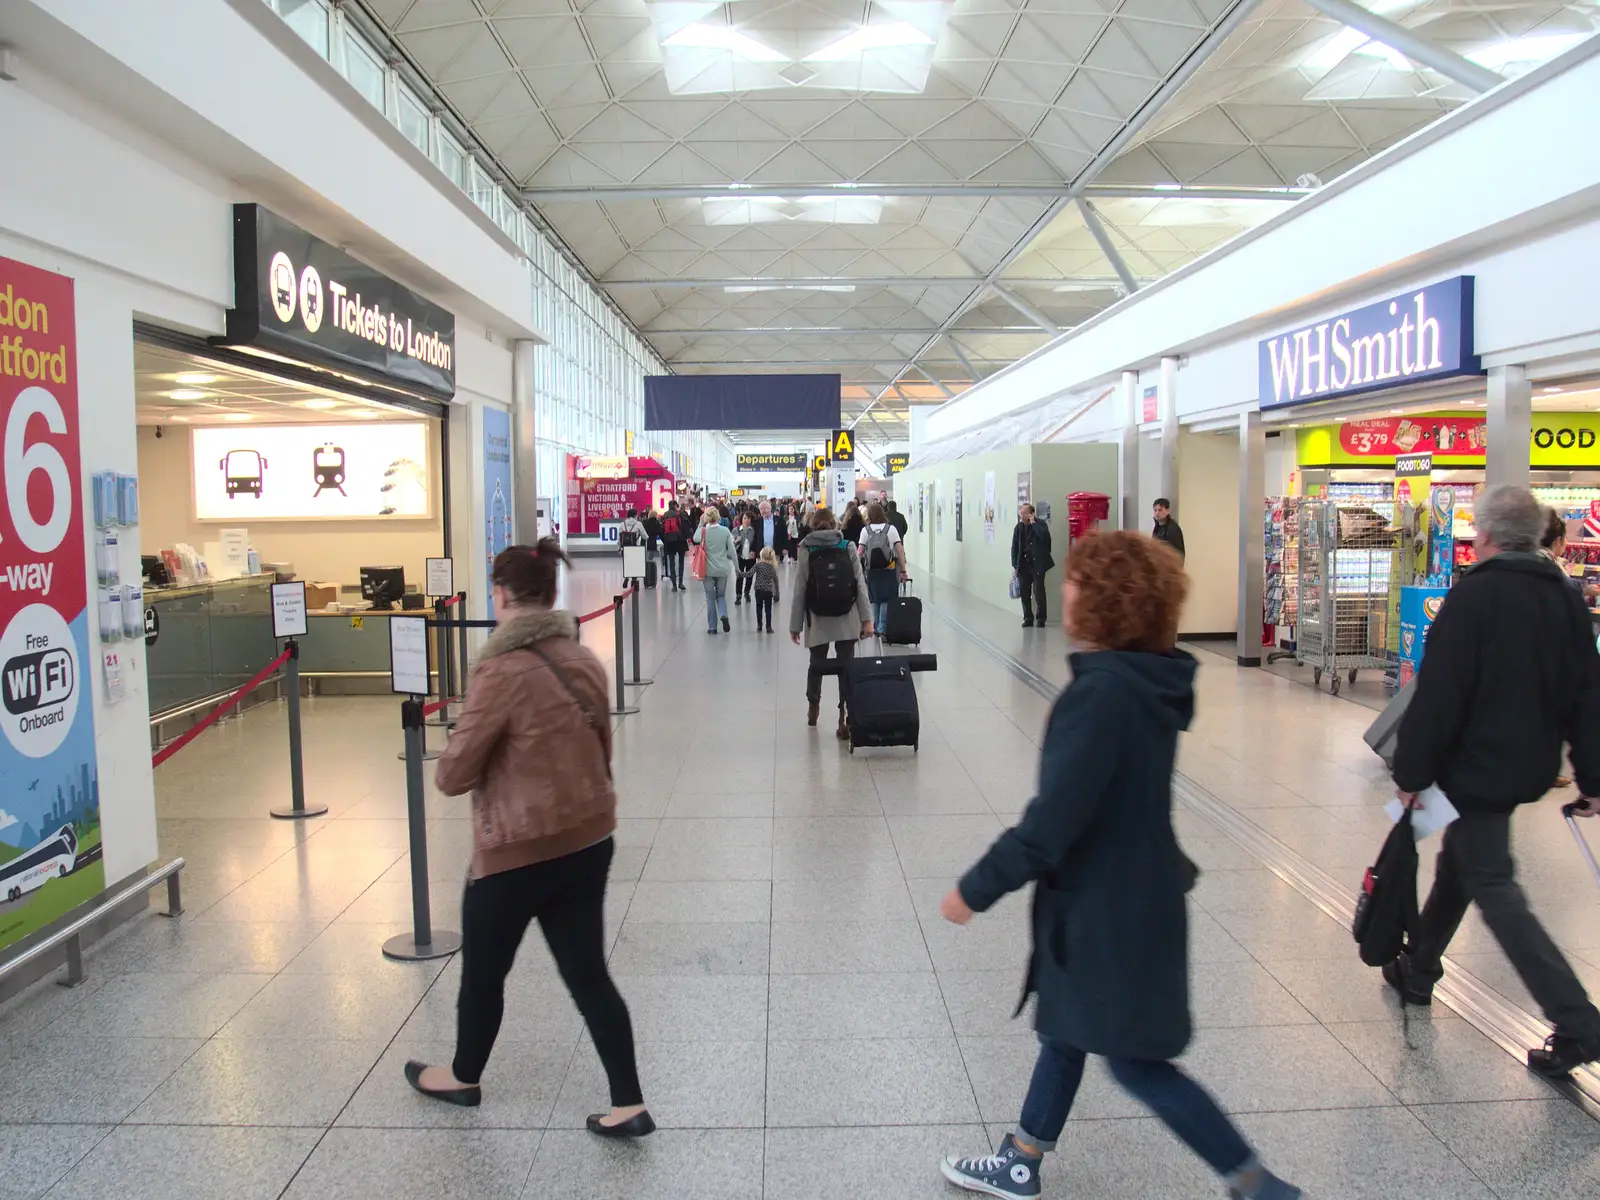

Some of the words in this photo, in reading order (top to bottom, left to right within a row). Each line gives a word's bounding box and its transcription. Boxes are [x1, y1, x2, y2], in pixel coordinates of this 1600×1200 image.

[329, 280, 388, 343] Tickets
[389, 319, 405, 349] to
[406, 320, 452, 371] London
[1267, 292, 1442, 402] WHSmith
[0, 335, 67, 384] tford
[1371, 420, 1390, 428] DEAL
[834, 431, 853, 453] A
[1530, 427, 1597, 449] OOD
[4, 386, 72, 553] 6
[737, 454, 796, 465] Departures
[587, 494, 619, 502] VICTORIA
[620, 493, 626, 502] &
[596, 483, 637, 492] STRATFORD
[588, 503, 625, 511] LIVERPOOL
[26, 633, 49, 651] Free
[106, 654, 119, 667] 21
[19, 708, 65, 734] Onboard
